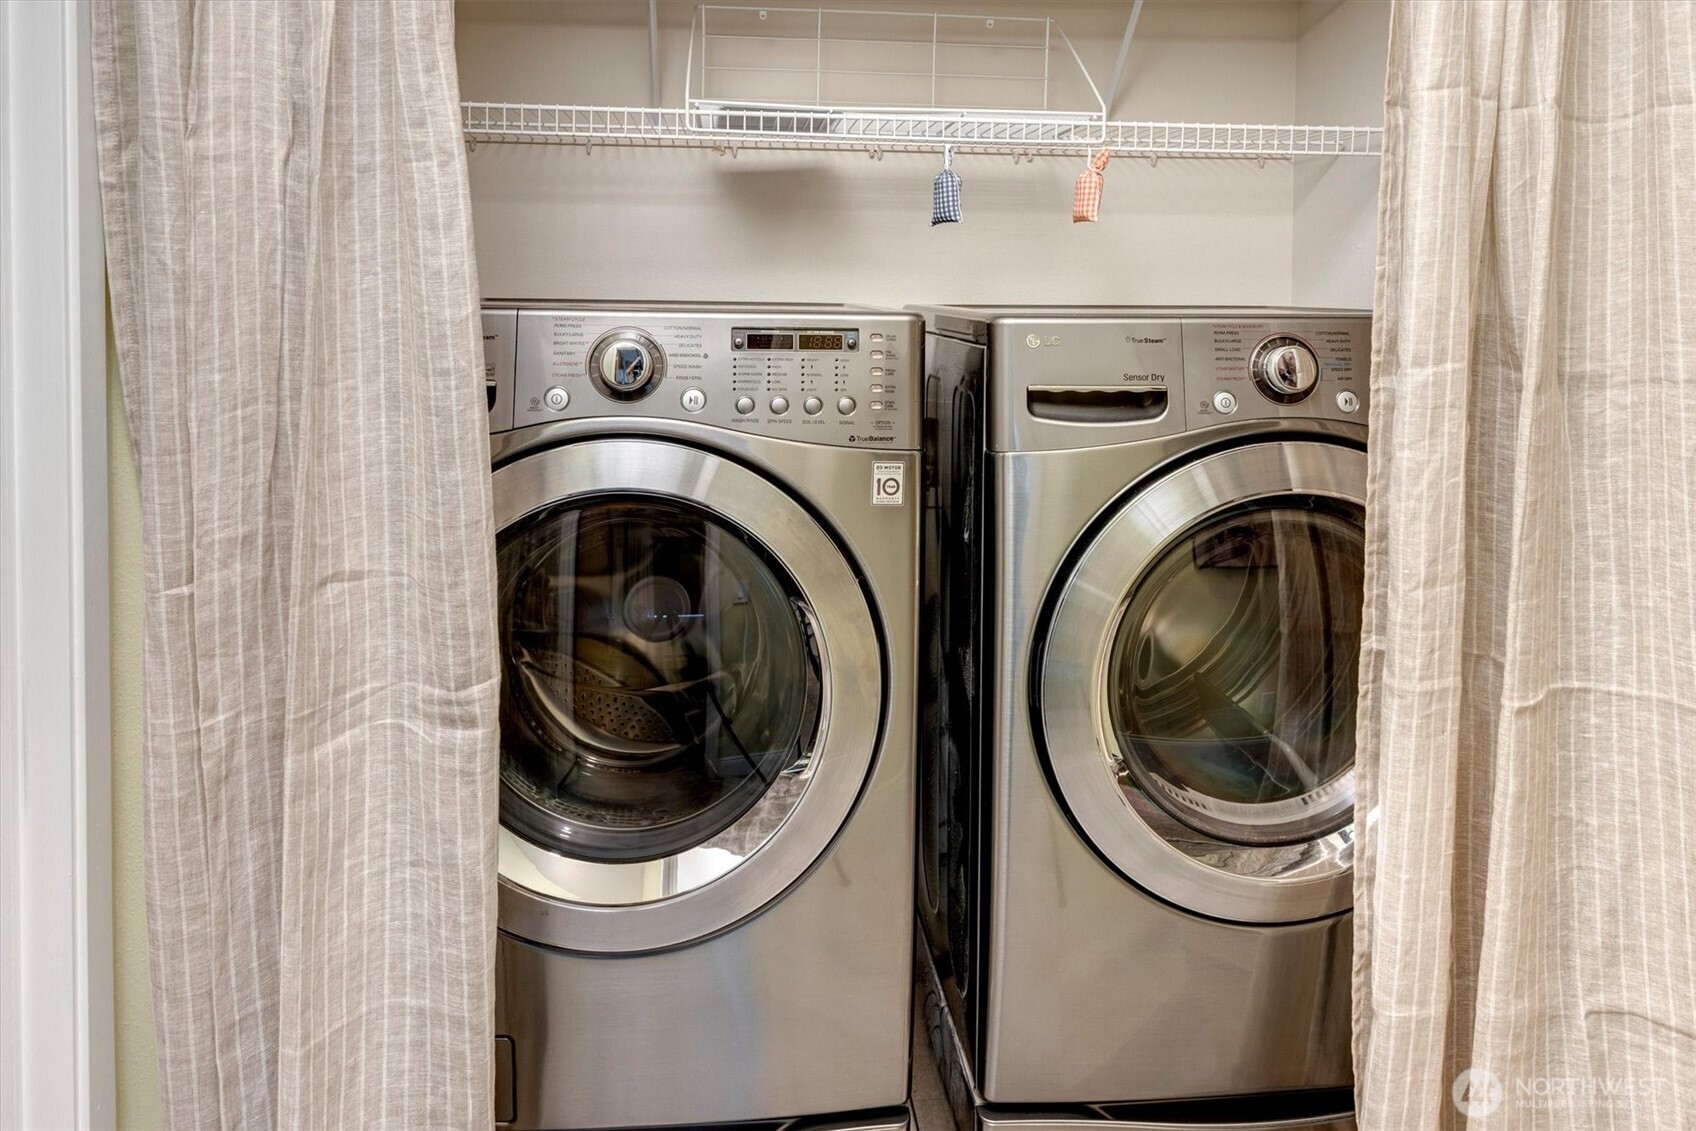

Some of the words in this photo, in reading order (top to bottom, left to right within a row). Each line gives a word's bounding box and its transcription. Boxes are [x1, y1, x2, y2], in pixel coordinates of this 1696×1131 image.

[1044, 336, 1060, 346] LG
[1151, 374, 1165, 382] Dry
[876, 478, 900, 496] 10
